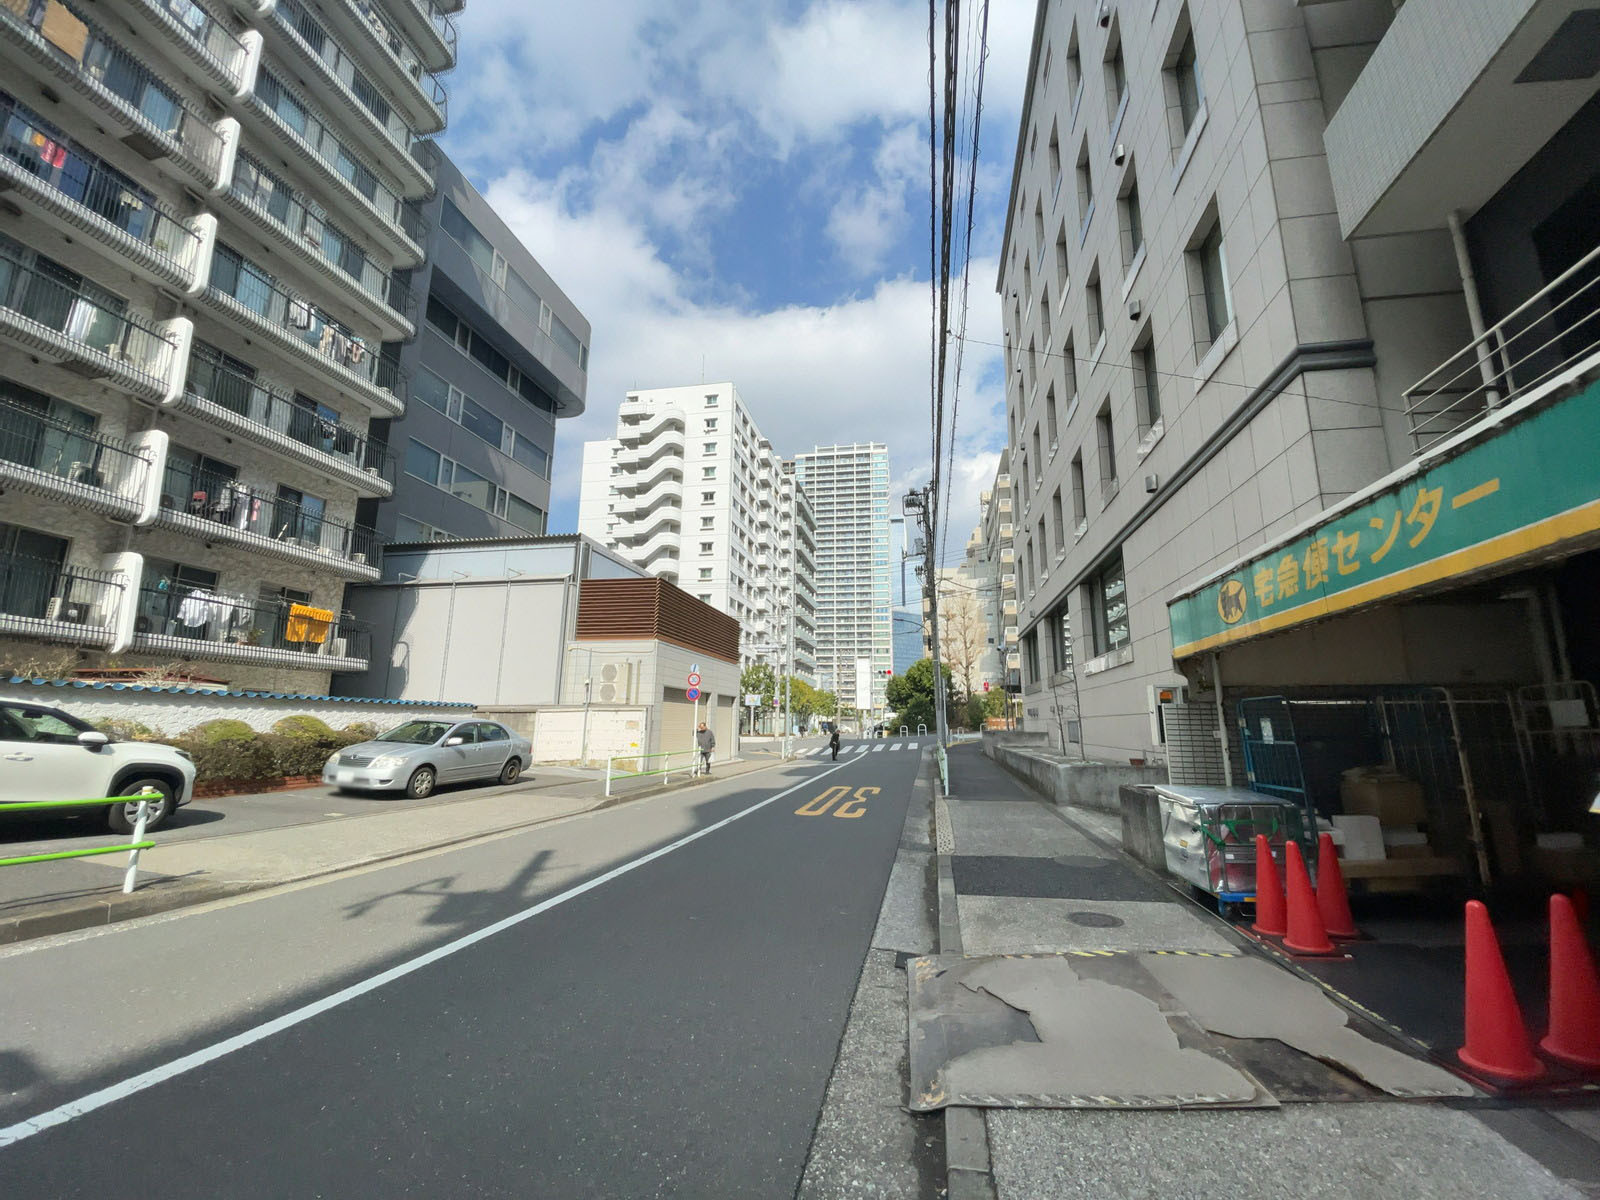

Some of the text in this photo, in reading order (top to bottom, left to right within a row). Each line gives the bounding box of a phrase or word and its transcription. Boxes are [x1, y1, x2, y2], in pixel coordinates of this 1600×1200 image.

[1254, 479, 1500, 608] 宅急便センター
[795, 786, 881, 818] 30
